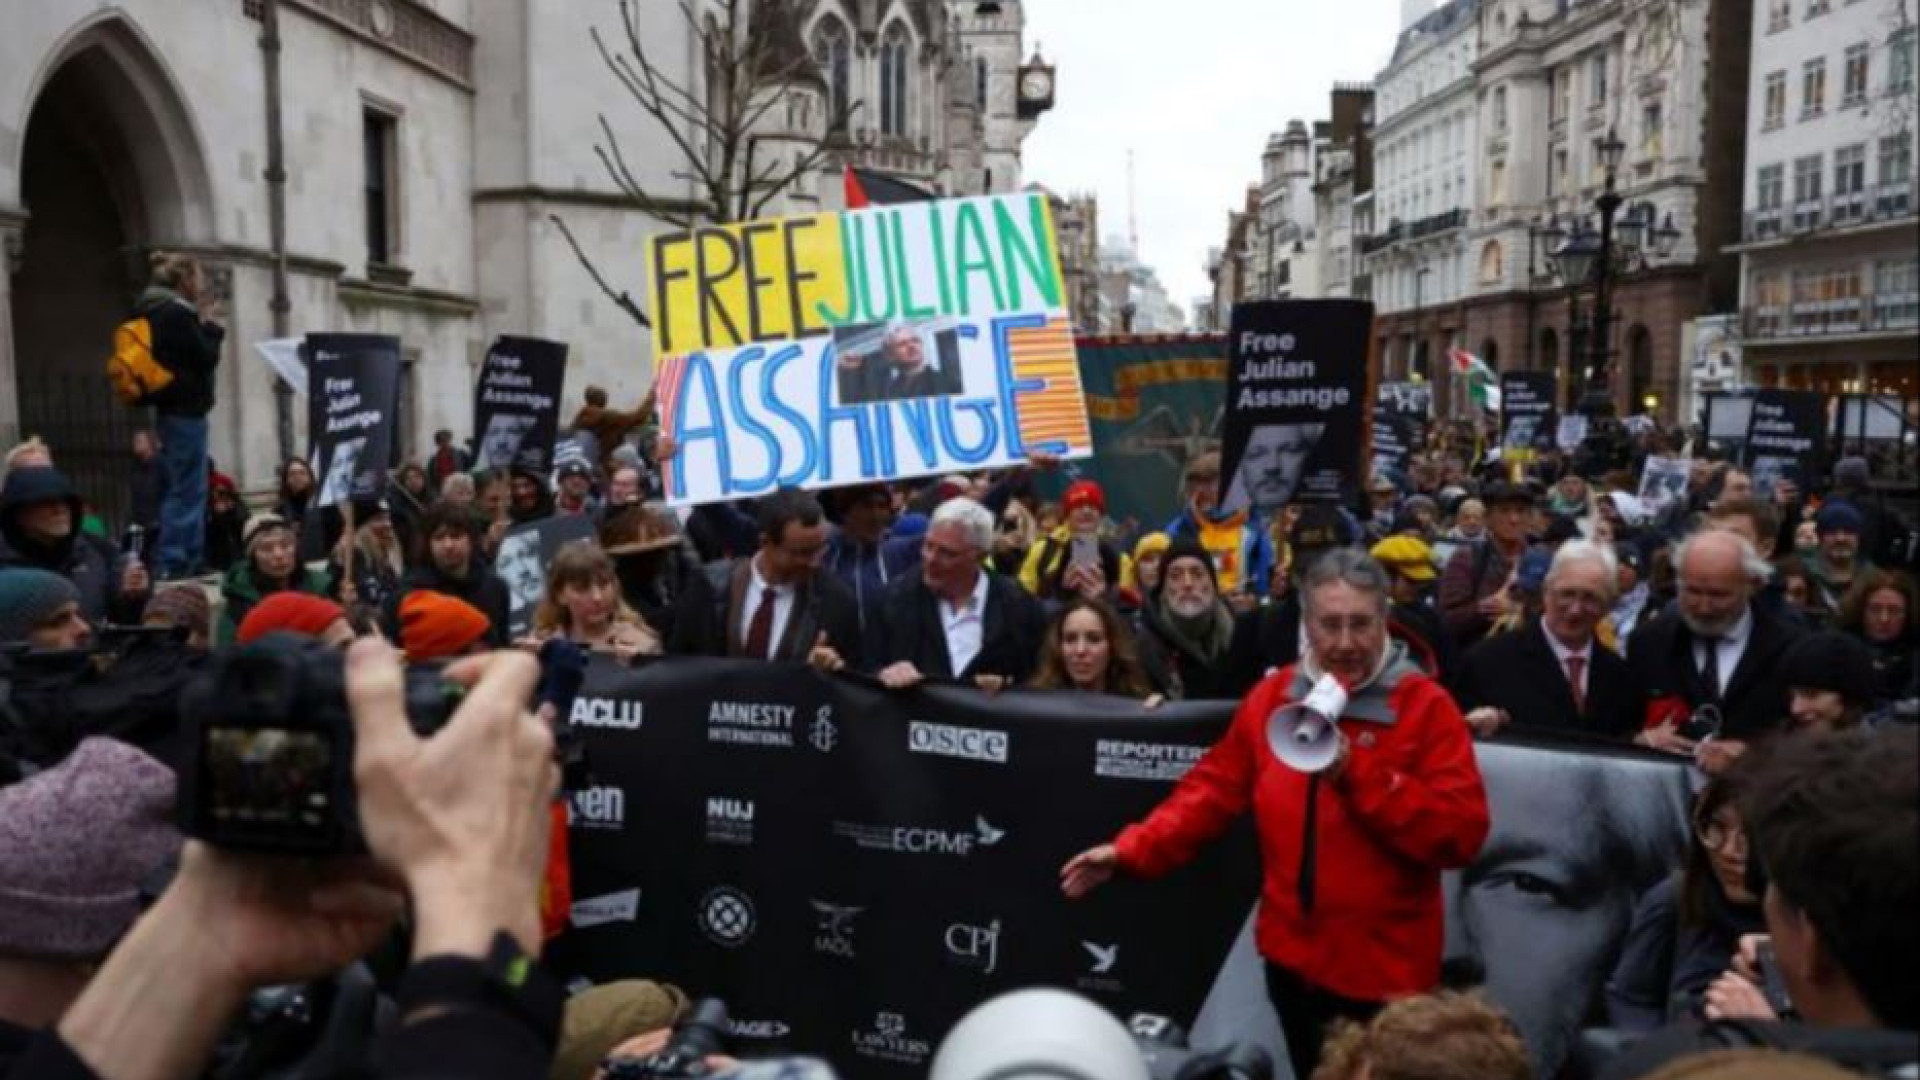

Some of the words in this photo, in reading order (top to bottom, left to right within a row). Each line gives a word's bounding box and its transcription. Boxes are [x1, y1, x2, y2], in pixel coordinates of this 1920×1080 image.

[653, 217, 829, 352] FREE
[814, 193, 1061, 327] JULIAN
[1240, 331, 1296, 353] Free
[491, 354, 521, 369] Free
[1238, 356, 1315, 382] Julian
[485, 372, 532, 388] Julian
[481, 387, 552, 410] Assange
[672, 313, 1069, 499] ASSANGE
[1237, 386, 1349, 410] Assange
[569, 697, 643, 729] ACLU
[708, 701, 796, 728] AMNESTY
[707, 798, 755, 821] NUJ
[892, 827, 973, 856] ECPMF
